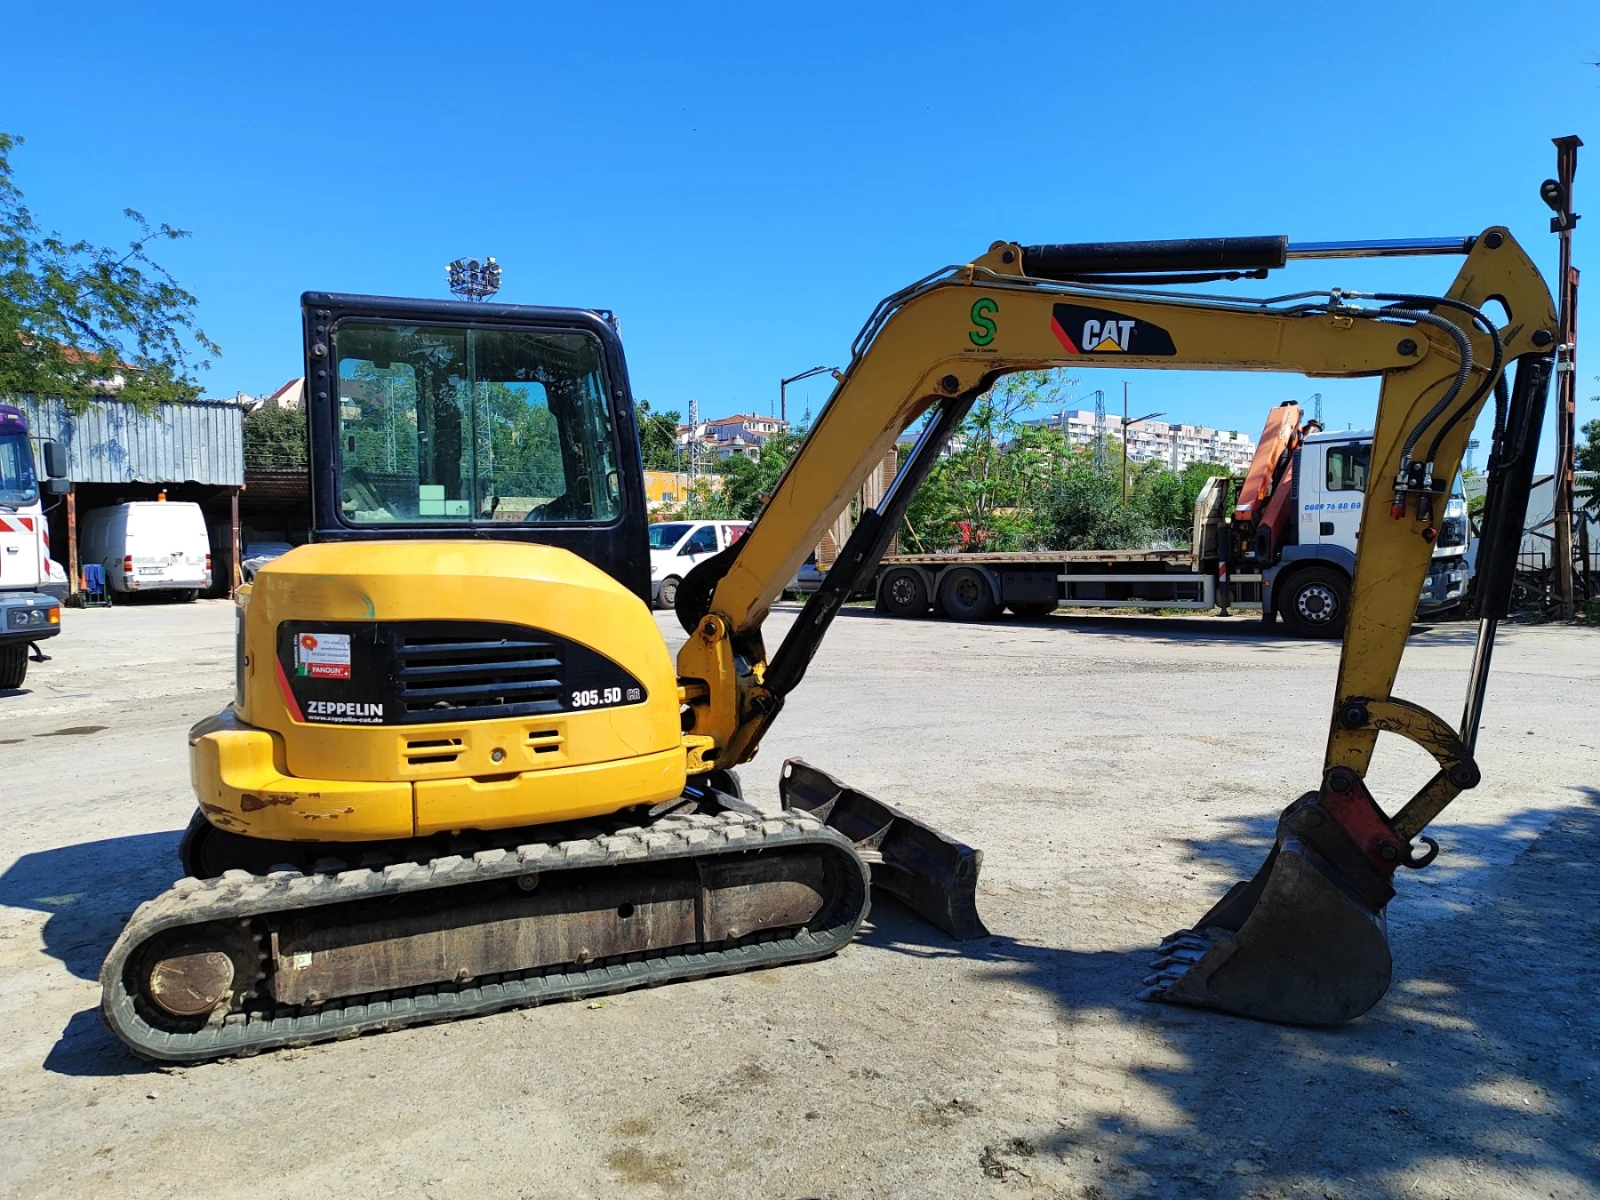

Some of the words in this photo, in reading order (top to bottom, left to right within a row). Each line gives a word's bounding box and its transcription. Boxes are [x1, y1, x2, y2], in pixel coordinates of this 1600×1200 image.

[968, 297, 999, 347] S
[1082, 319, 1135, 351] CAT
[307, 701, 383, 716] ZEPPELIN
[571, 687, 621, 707] 305.5D
[626, 688, 641, 701] CR
